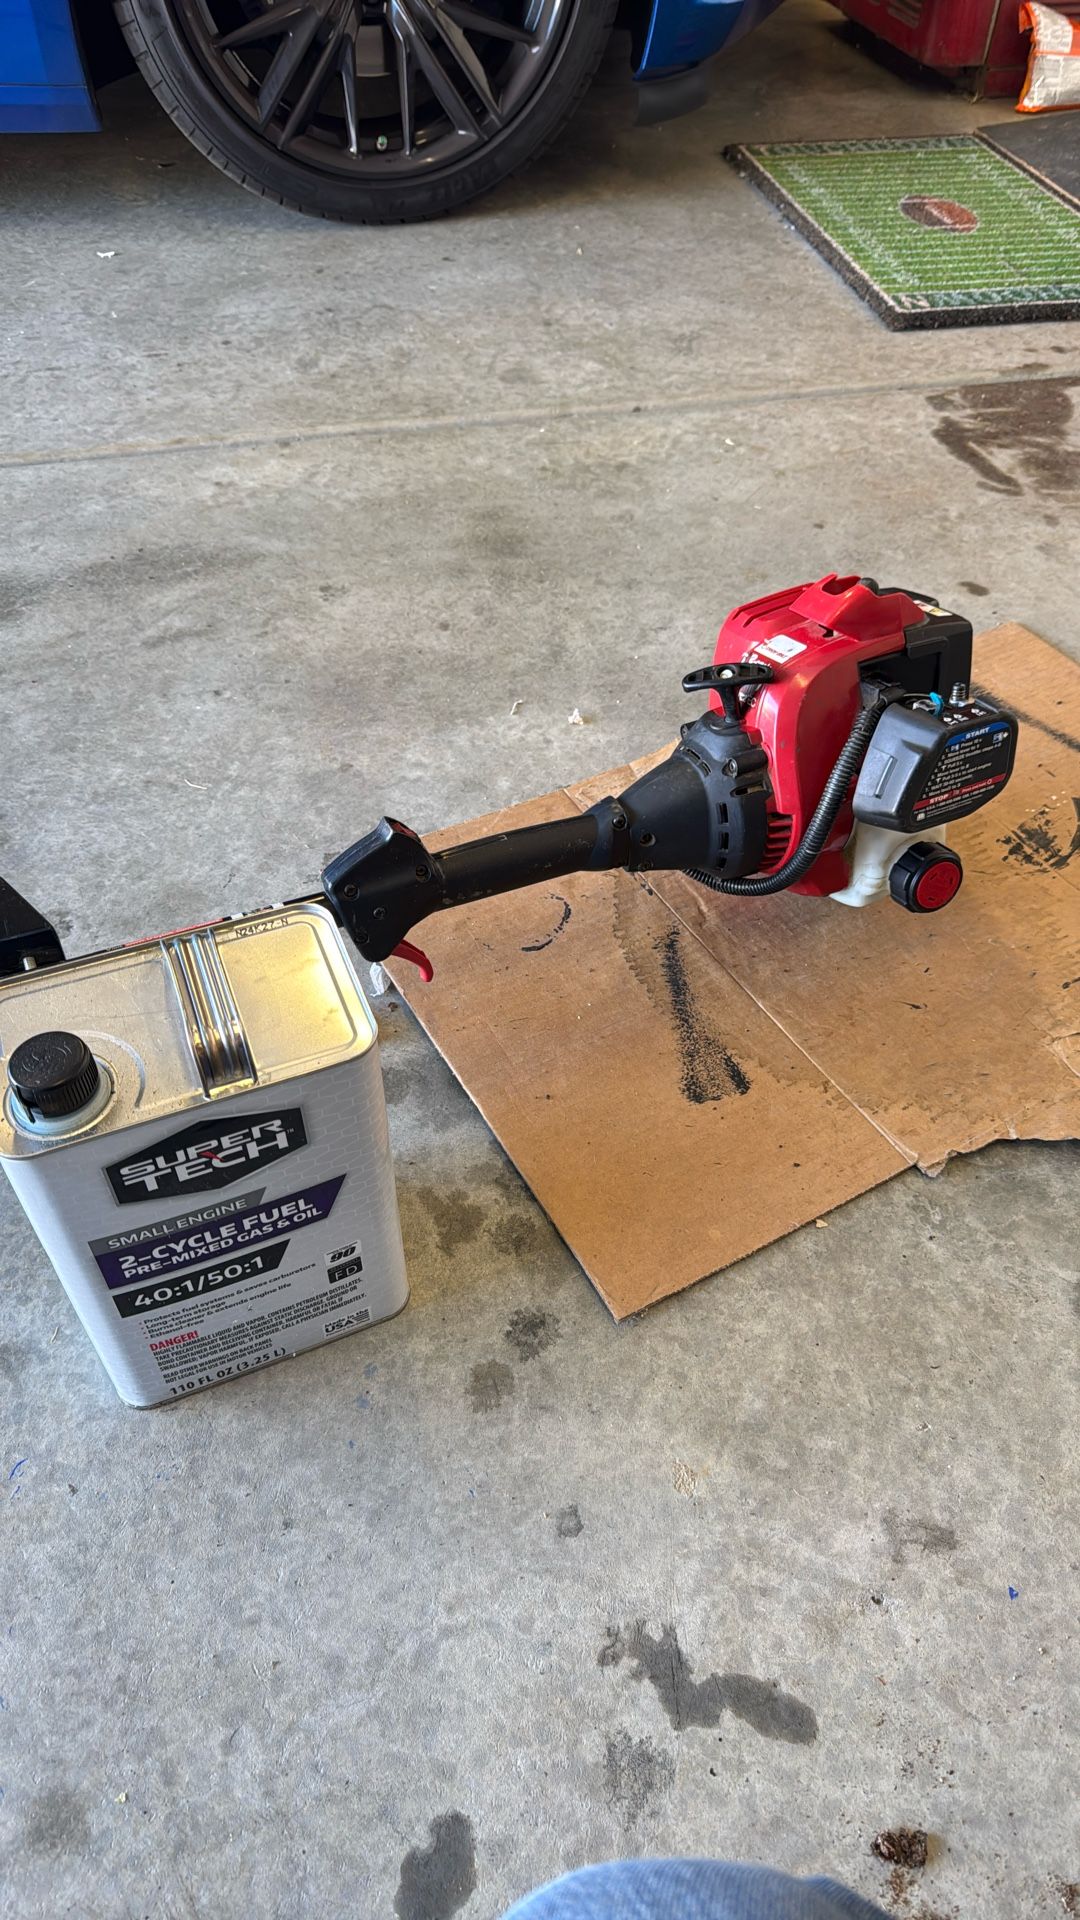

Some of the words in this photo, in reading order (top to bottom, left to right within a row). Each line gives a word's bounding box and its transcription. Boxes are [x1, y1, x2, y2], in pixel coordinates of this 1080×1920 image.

[965, 726, 990, 739] START
[929, 793, 948, 804] STOP
[119, 1119, 283, 1176] SUPER
[124, 1131, 288, 1191] TECH
[108, 1224, 173, 1248] SMALL
[176, 1198, 246, 1228] ENGINE
[118, 1222, 237, 1269] 2-CYCLE
[242, 1198, 313, 1230] FUEL
[123, 1238, 233, 1278] PRE-MIXED
[236, 1223, 273, 1241] GAS
[276, 1218, 290, 1228] &
[293, 1207, 322, 1222] OIL
[329, 1245, 356, 1262] 90
[134, 1256, 263, 1305] 40:1/50:1
[181, 1303, 198, 1312] fuel
[199, 1292, 234, 1307] systems
[268, 1263, 315, 1283] carburetors
[249, 1288, 277, 1300] engine
[277, 1282, 291, 1290] life
[155, 1353, 169, 1361] TAKE
[218, 1326, 249, 1341] MEASURES
[249, 1317, 273, 1330] AGAINST
[273, 1310, 293, 1321] STATIC
[325, 1288, 349, 1301] GROUND
[349, 1284, 357, 1292] OR
[198, 1349, 218, 1359] VAPOR
[281, 1321, 294, 1329] CALL
[300, 1308, 328, 1322] PHYSICIAN
[208, 1342, 221, 1350] AND
[285, 1309, 311, 1322] HARMFUL
[320, 1299, 337, 1309] FATAL
[211, 1327, 232, 1338] LIQUID
[232, 1322, 245, 1330] AND
[267, 1304, 295, 1318] CONTAINS
[295, 1291, 328, 1307] PETROLEUM
[324, 1317, 354, 1333] USA
[149, 1330, 198, 1351] DANGER!
[169, 1381, 194, 1394] 110
[197, 1375, 213, 1385] FL
[216, 1366, 233, 1378] OZ
[236, 1352, 270, 1371] (3.25
[273, 1347, 285, 1357] L)
